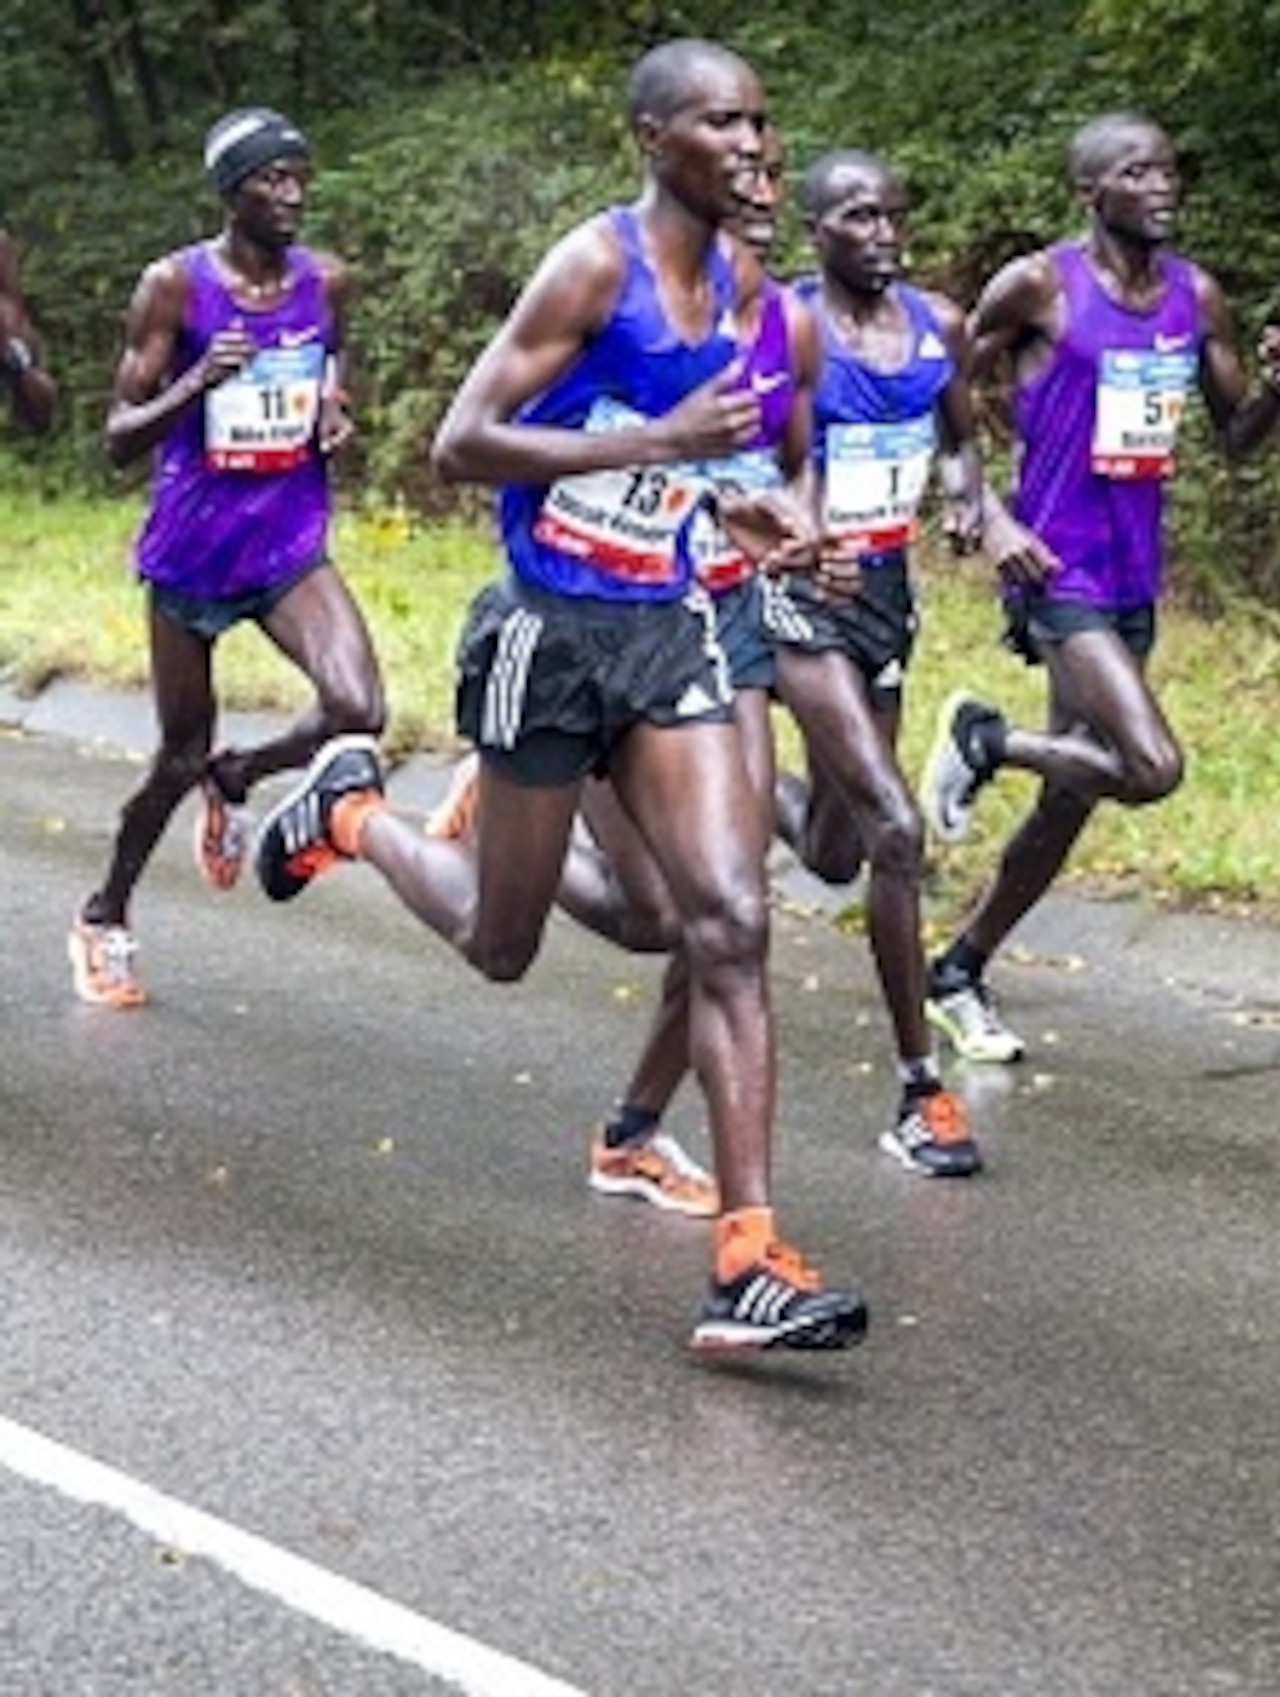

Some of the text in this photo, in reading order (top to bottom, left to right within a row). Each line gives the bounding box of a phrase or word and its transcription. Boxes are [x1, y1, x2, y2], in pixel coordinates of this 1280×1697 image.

[258, 387, 284, 420] 11
[1144, 391, 1162, 425] 5
[622, 472, 667, 517] 13
